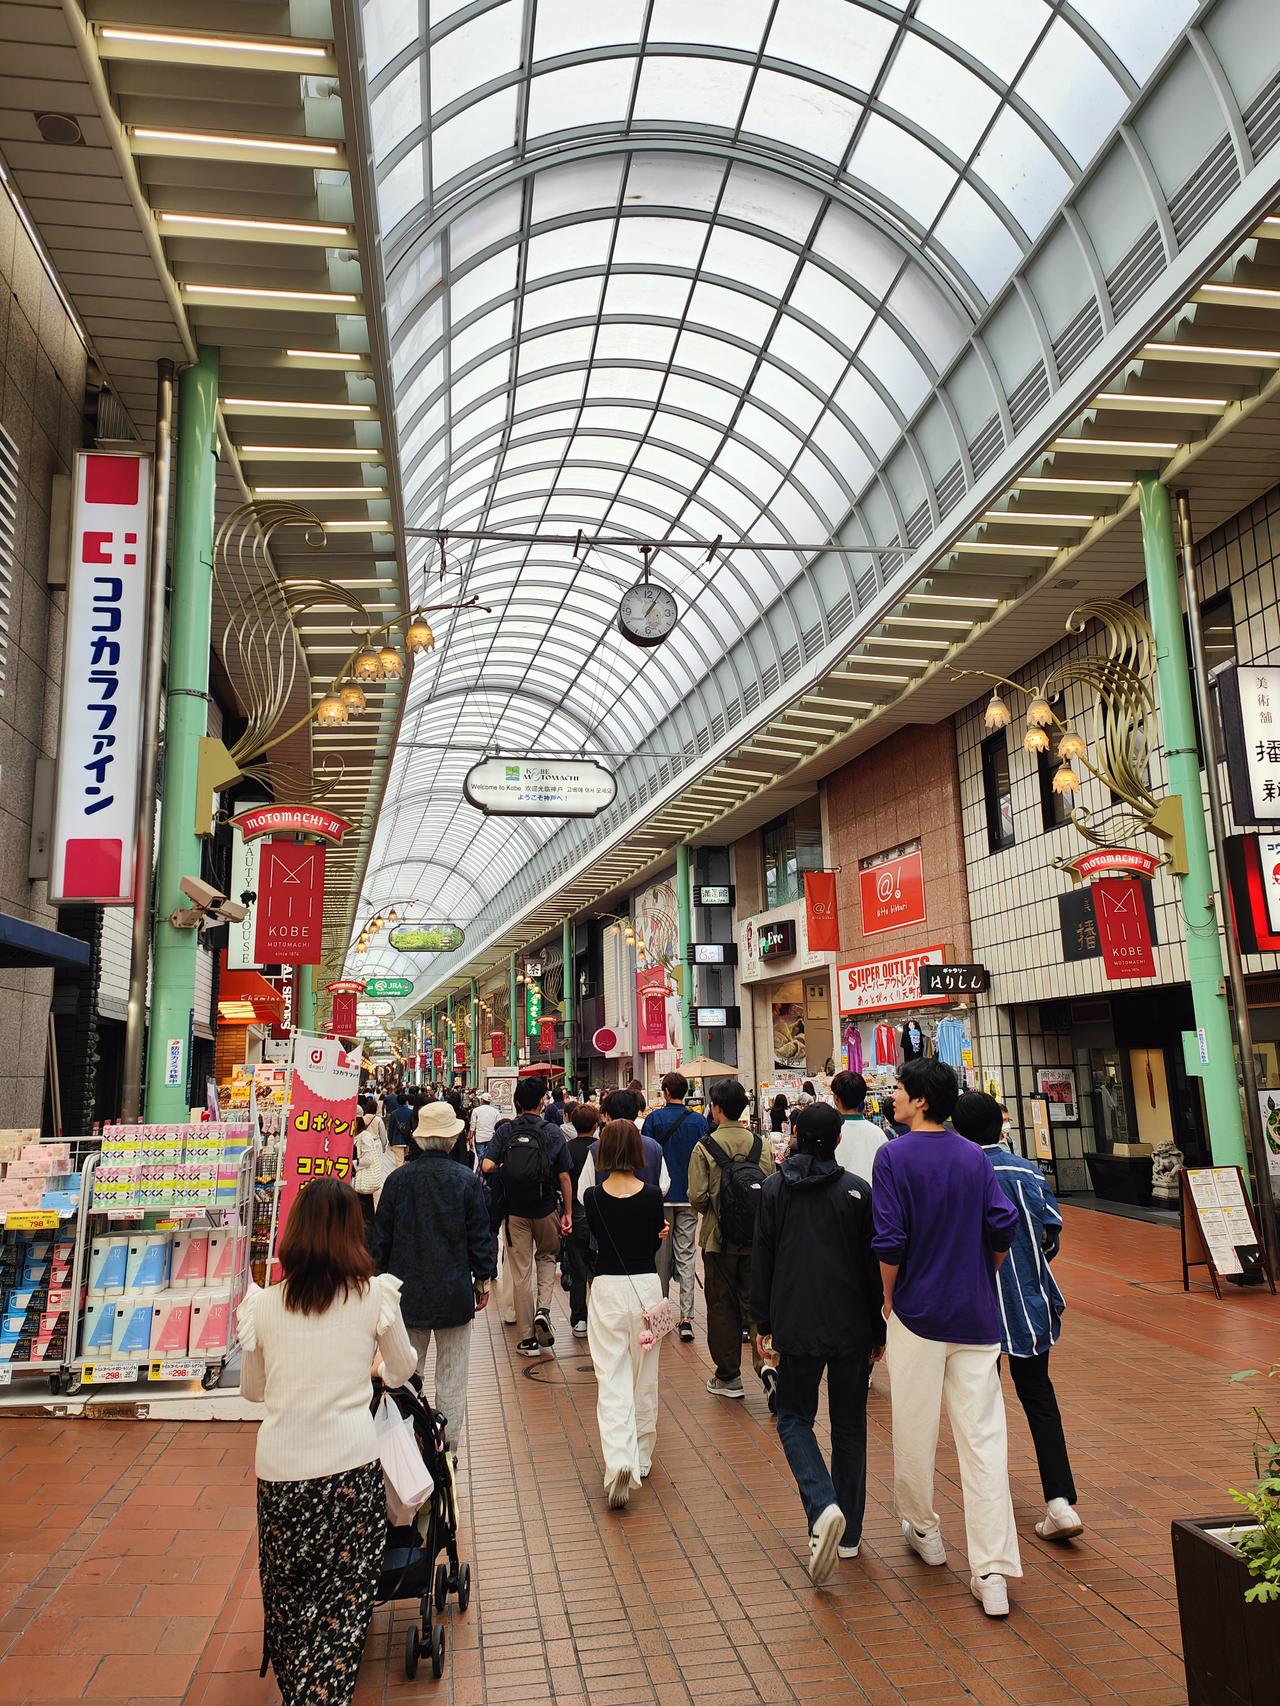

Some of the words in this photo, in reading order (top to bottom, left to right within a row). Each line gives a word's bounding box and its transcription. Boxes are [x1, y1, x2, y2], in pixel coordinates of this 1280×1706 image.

[645, 591, 653, 599] 12
[664, 609, 671, 617] 3
[645, 626, 651, 634] 6
[83, 577, 123, 815] ココカラファイン
[1256, 676, 1273, 724] 美術舗
[523, 774, 579, 782] MOTOMACHI
[471, 783, 498, 791] Welcome
[246, 811, 341, 834] MOTOMACHI-III
[243, 841, 254, 887] EAUTY
[1081, 854, 1152, 872] MOTOMACHI-III
[268, 926, 310, 937] KOBE
[767, 931, 784, 946] Eve
[1112, 946, 1144, 957] KOBE
[848, 964, 880, 992] SUPER
[882, 955, 931, 978] OUTLETS
[861, 973, 918, 993] スーパーアウトレット
[930, 975, 982, 989] はりしん
[857, 987, 923, 1006] あっとびっくり元町店
[297, 1156, 350, 1179] ココカラ
[105, 1372, 120, 1380] 298
[171, 1369, 187, 1377] 298
